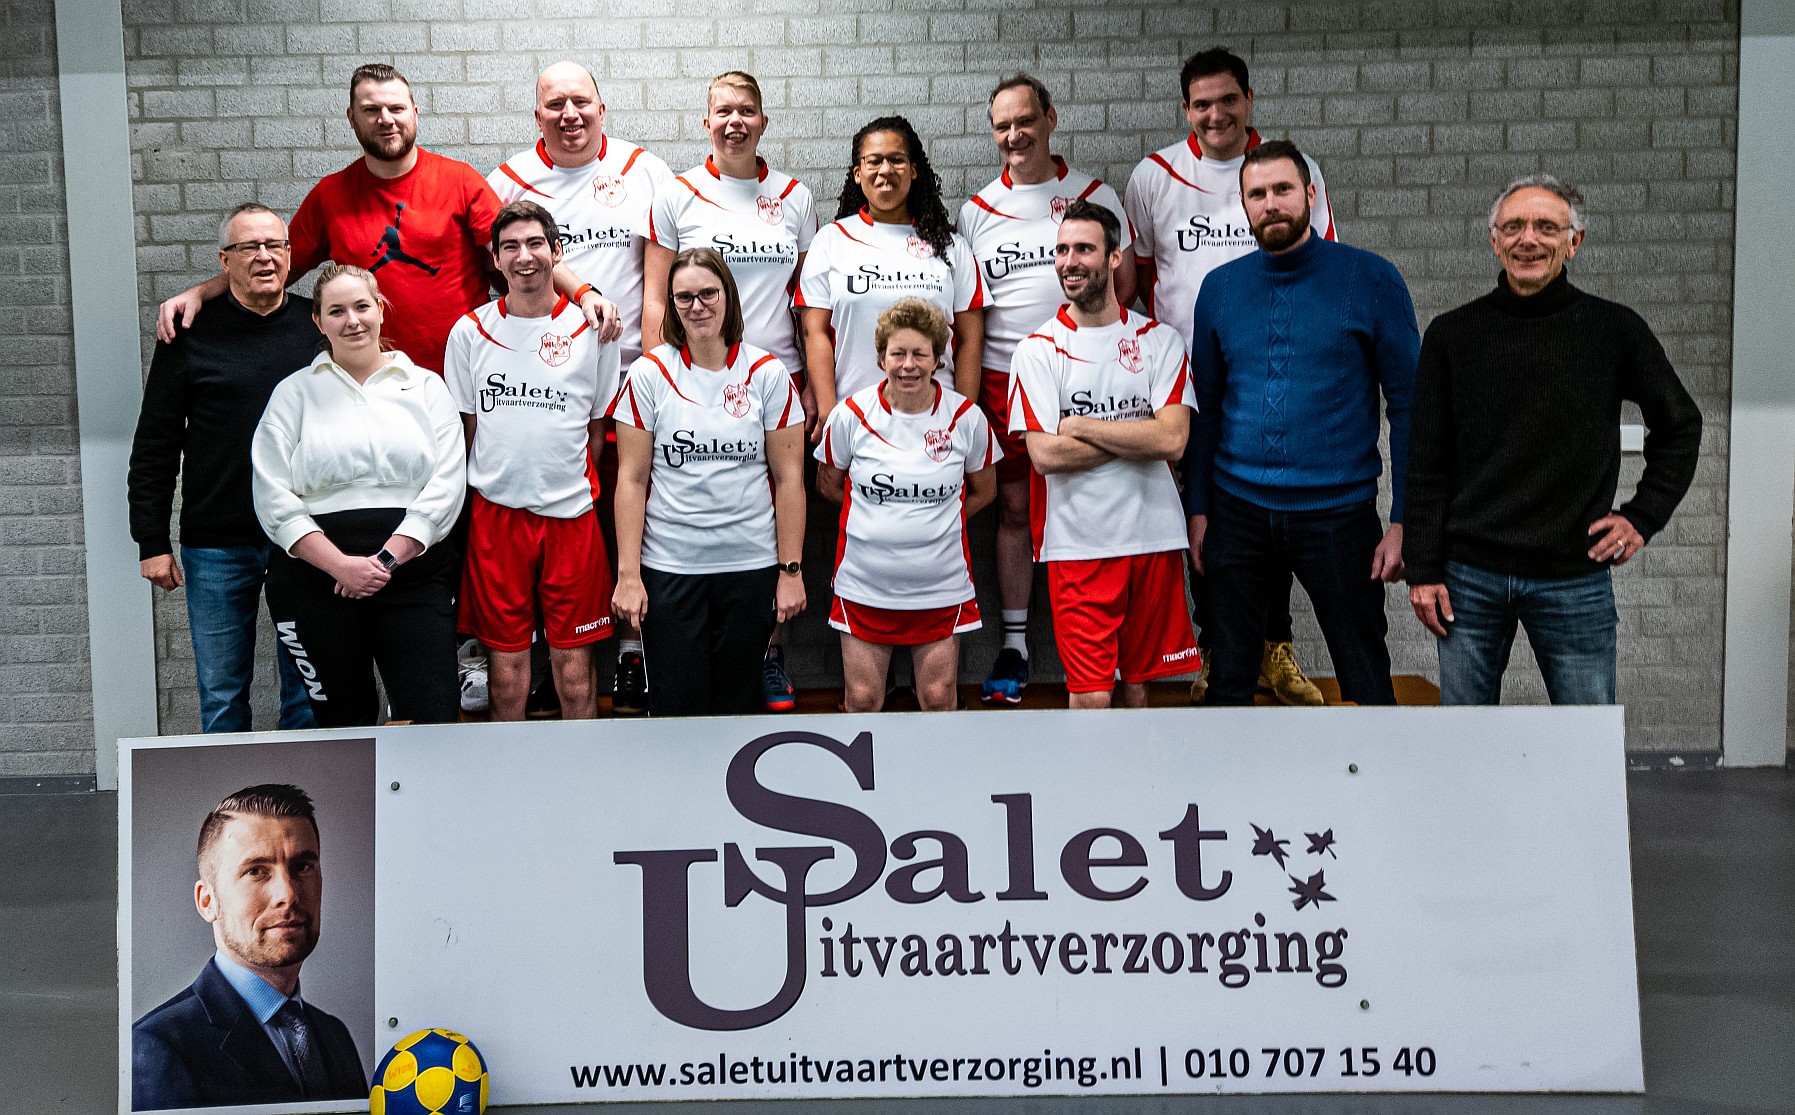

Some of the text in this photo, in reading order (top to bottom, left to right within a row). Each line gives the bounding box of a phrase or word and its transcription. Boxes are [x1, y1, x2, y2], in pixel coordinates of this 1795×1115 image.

[712, 234, 784, 255] Salet
[997, 242, 1057, 263] Sale
[859, 264, 927, 282] Salet
[487, 373, 554, 399] Salet
[479, 389, 567, 413] Uitvaartverzorging
[1071, 390, 1140, 416] Salet
[673, 430, 747, 454] Salet
[661, 444, 758, 468] Uitvaartverzorging
[871, 473, 948, 498] Salet
[575, 616, 610, 634] macron
[277, 621, 328, 701] WION
[1162, 647, 1198, 663] macron
[725, 729, 1233, 907] Salet
[613, 843, 1349, 1031] Uitvaartverzorging
[570, 1047, 1142, 1088] www.saletuitvaartverzorging.nl
[1184, 1047, 1250, 1079] 010
[1261, 1046, 1326, 1078] 707
[1339, 1046, 1381, 1077] 15
[1392, 1045, 1437, 1077] 40
